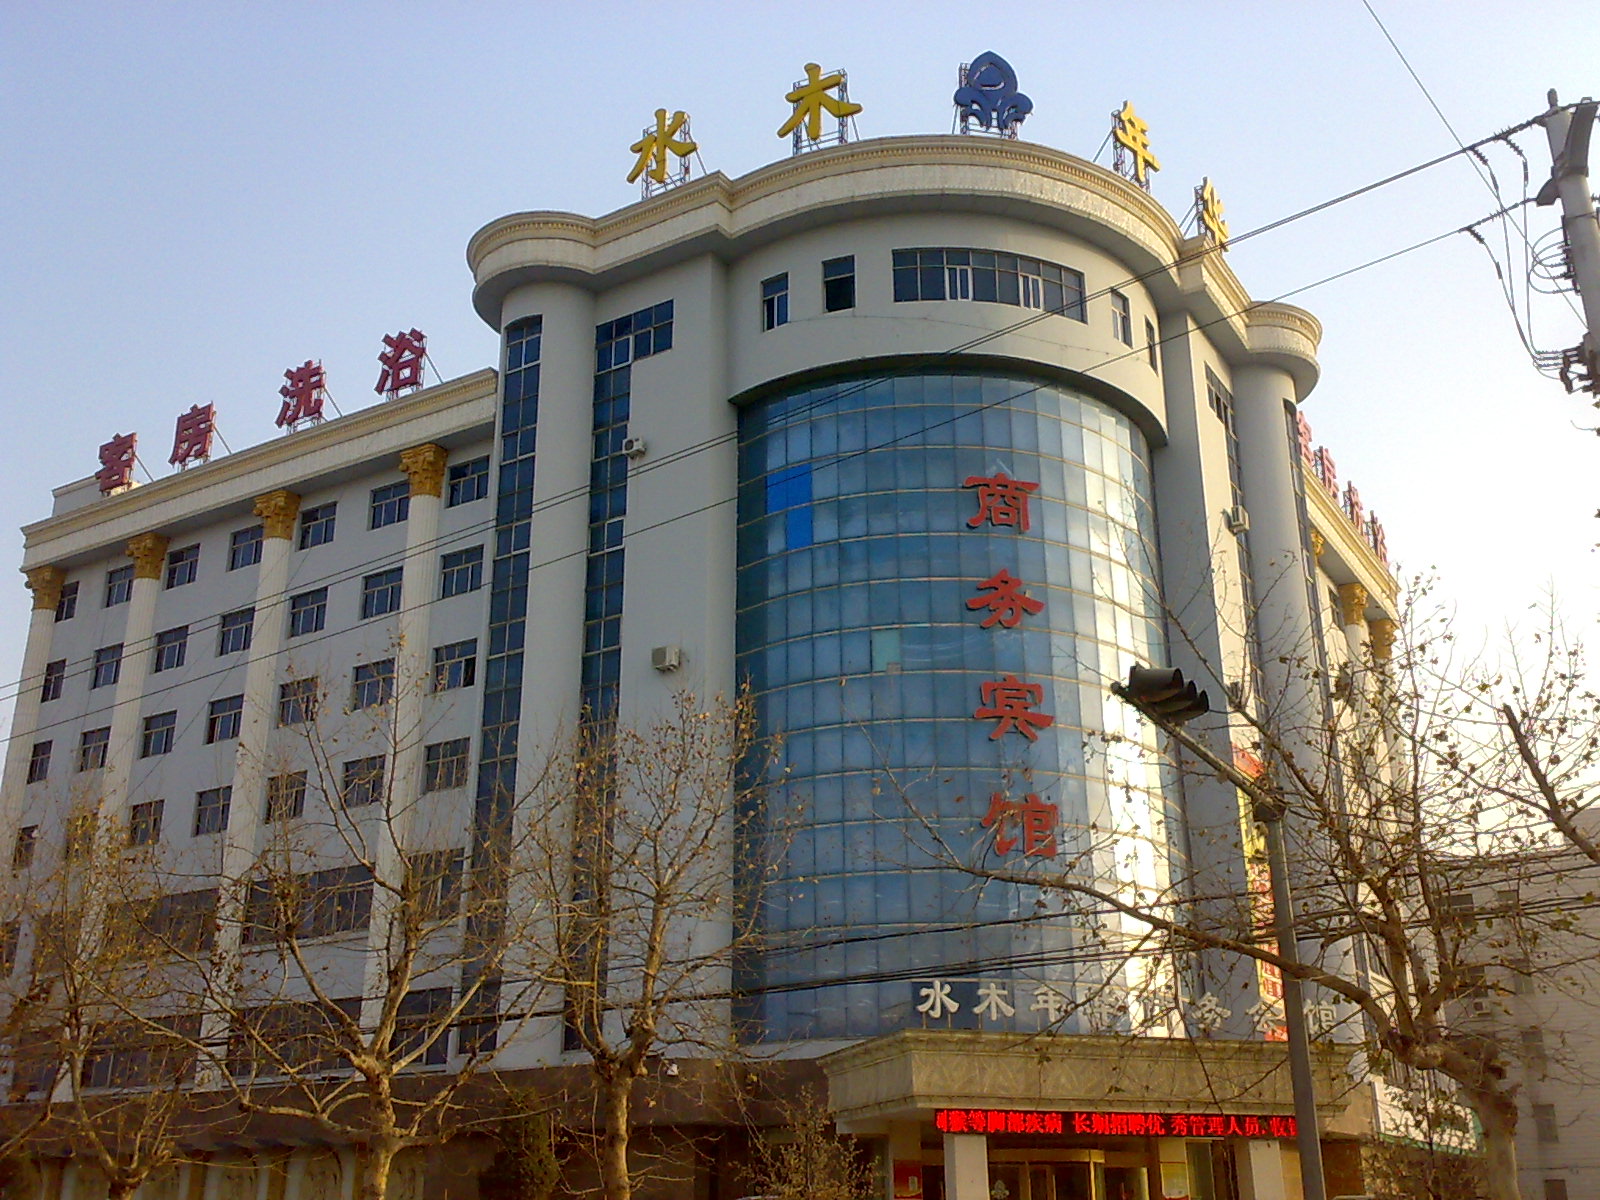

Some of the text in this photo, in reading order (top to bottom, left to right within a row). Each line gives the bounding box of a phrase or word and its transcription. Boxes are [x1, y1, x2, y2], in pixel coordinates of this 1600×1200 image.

[95, 328, 426, 491] 客房洗浴
[964, 472, 1059, 858] 商务宾馆
